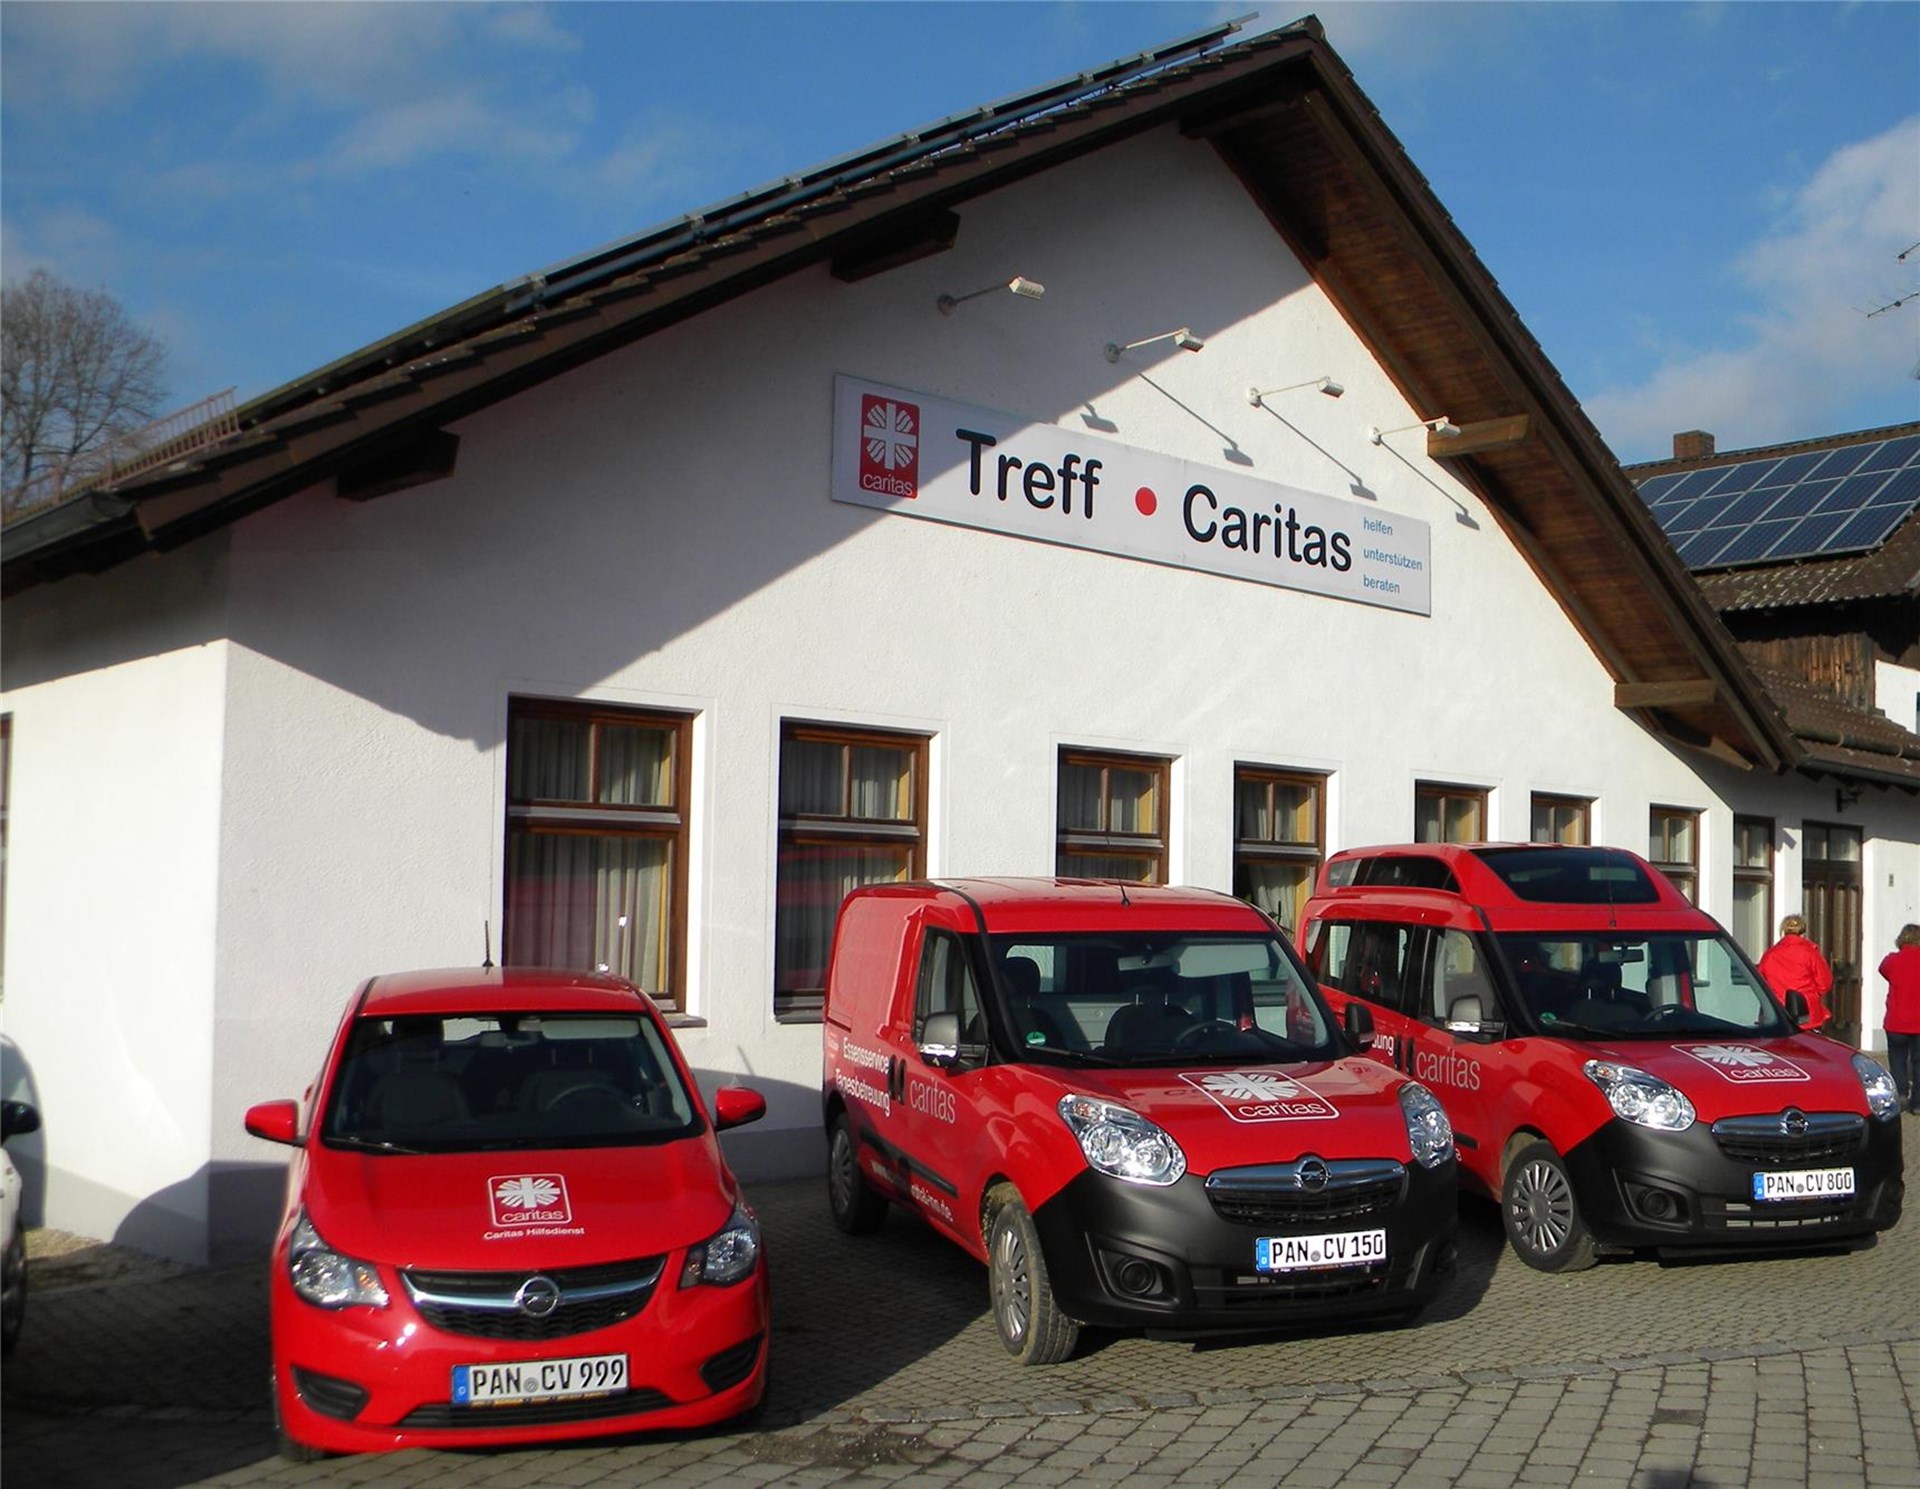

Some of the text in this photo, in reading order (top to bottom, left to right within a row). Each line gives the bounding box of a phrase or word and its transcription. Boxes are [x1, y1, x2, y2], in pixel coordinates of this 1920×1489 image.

[863, 473, 913, 497] caritas
[956, 428, 1352, 572] Treff Caritas
[1363, 517, 1394, 536] helfen
[1363, 548, 1423, 571] unterstützen
[1363, 574, 1400, 594] beraten
[1416, 1046, 1480, 1091] caritas
[1731, 1068, 1800, 1079] caritas
[909, 1077, 956, 1125] caritas
[1239, 1102, 1326, 1118] caritas
[1766, 1172, 1852, 1194] PAN CV 800
[501, 1209, 565, 1223] caritas
[483, 1227, 585, 1240] Caritas Hilfsdienst
[1272, 1234, 1383, 1264] PAN CV 150
[472, 1358, 624, 1396] PAN CV 999
